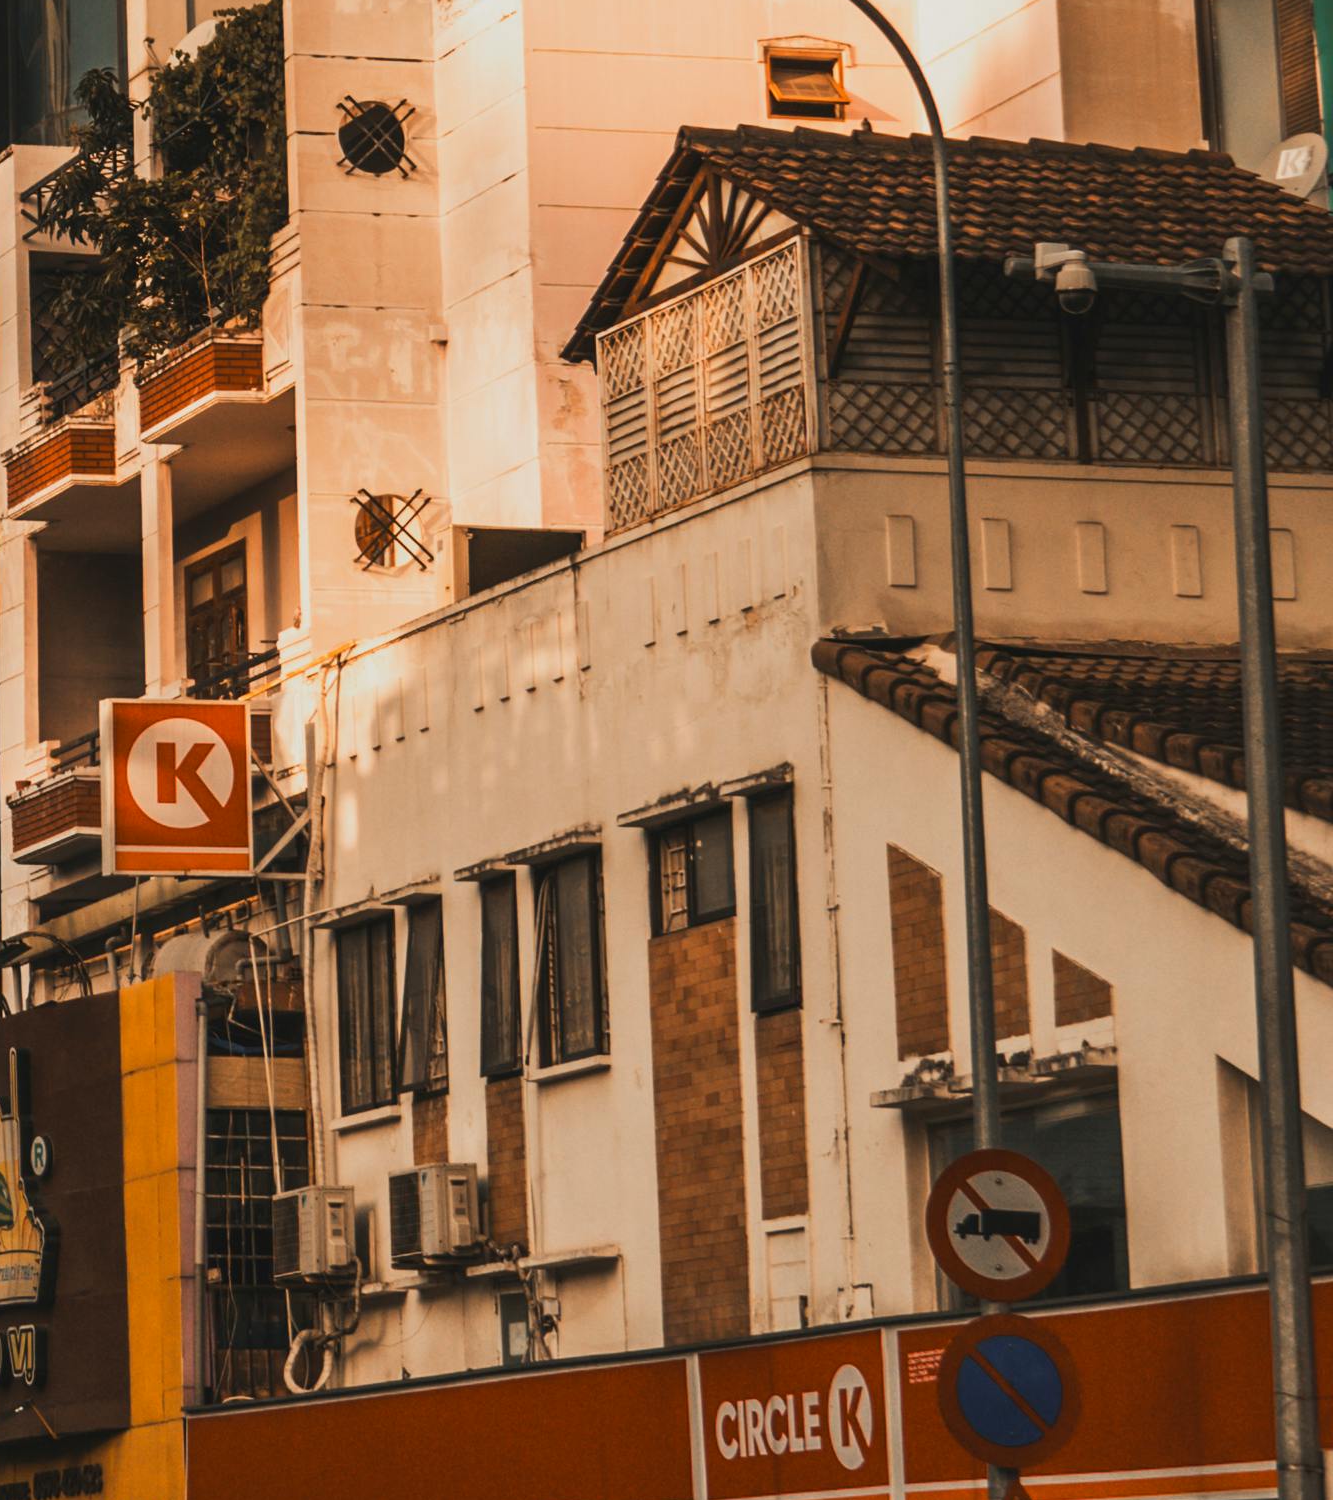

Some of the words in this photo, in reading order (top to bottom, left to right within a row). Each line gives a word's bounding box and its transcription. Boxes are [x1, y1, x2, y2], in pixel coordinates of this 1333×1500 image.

[153, 738, 228, 828] K
[7, 1324, 36, 1386] VỊ
[715, 1390, 823, 1460] CIRCLE
[835, 1376, 871, 1466] K
